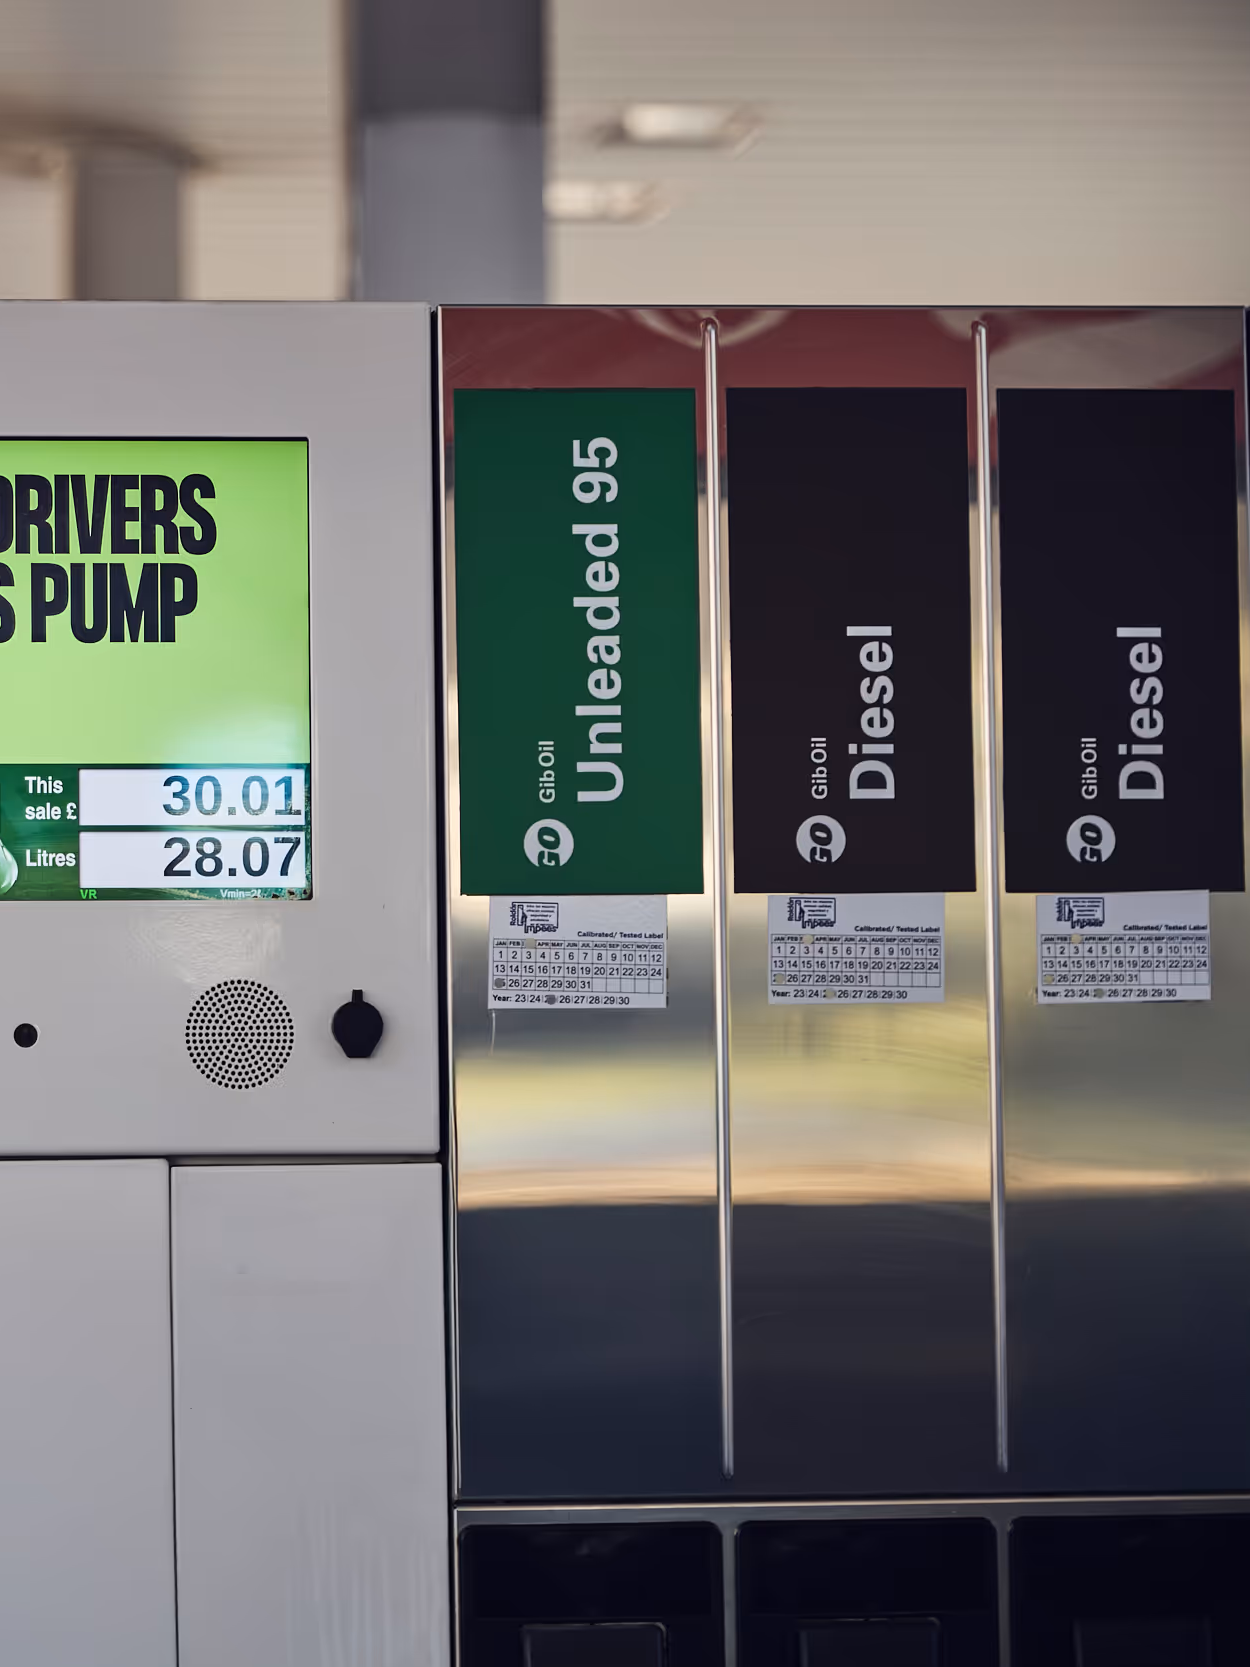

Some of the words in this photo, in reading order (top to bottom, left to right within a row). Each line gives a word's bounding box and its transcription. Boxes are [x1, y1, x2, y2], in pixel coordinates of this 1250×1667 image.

[573, 437, 618, 503] 95
[31, 563, 198, 643] PUMP
[572, 524, 624, 802] Unleaded
[847, 626, 895, 799] Diesel
[1117, 627, 1164, 799] Diesel
[25, 776, 63, 793] This
[163, 776, 301, 816] 30.01
[25, 803, 61, 820] sale
[66, 803, 77, 820] £
[26, 849, 76, 866] Litres
[164, 837, 301, 876] 28.07
[80, 889, 97, 899] VR
[512, 951, 517, 959] 2
[526, 951, 531, 959] 3
[555, 952, 560, 960] 5
[569, 952, 574, 960] 6
[583, 952, 588, 960] 7
[597, 953, 602, 961] 8
[611, 953, 617, 961] 9
[639, 954, 646, 962] 11
[652, 954, 661, 962] 12
[790, 946, 796, 954] 2
[804, 946, 809, 954] 3
[832, 947, 838, 955] 5
[846, 947, 852, 955] 6
[860, 947, 866, 955] 7
[874, 947, 880, 956] 8
[888, 947, 894, 955] 9
[901, 948, 911, 956] 10
[916, 948, 924, 956] 11
[929, 948, 938, 956] 12
[1047, 946, 1050, 954] 1
[1060, 946, 1065, 954] 2
[1074, 946, 1079, 954] 3
[1102, 946, 1107, 954] 5
[1115, 946, 1121, 954] 6
[1144, 946, 1149, 954] 8
[1157, 946, 1163, 954] 9
[1169, 946, 1180, 954] 10
[1184, 946, 1193, 954] 11
[1197, 946, 1207, 954] 12
[496, 965, 505, 973] 13
[510, 965, 519, 973] 14
[538, 966, 548, 974] 16
[552, 966, 562, 974] 17
[566, 966, 576, 974] 18
[581, 967, 590, 975] 19
[594, 967, 606, 975] 20
[622, 968, 633, 976] 22
[637, 968, 648, 976] 23
[651, 968, 662, 976] 24
[774, 960, 784, 968] 13
[816, 961, 826, 969] 16
[830, 961, 840, 969] 17
[844, 961, 854, 969] 18
[858, 961, 868, 969] 19
[872, 961, 883, 970] 20
[886, 962, 896, 970] 21
[900, 962, 911, 970] 22
[914, 962, 925, 970] 23
[928, 962, 938, 970] 24
[1044, 960, 1054, 968] 13
[1072, 960, 1082, 968] 15
[1086, 960, 1096, 968] 16
[1100, 960, 1109, 968] 17
[1114, 960, 1124, 968] 18
[1128, 960, 1138, 968] 19
[1141, 960, 1152, 968] 20
[1156, 960, 1165, 968] 21
[1169, 960, 1180, 968] 22
[1183, 960, 1194, 968] 23
[1197, 960, 1207, 968] 24
[509, 979, 520, 987] 26
[523, 979, 534, 987] 27
[537, 980, 548, 988] 28
[551, 980, 562, 988] 29
[580, 981, 590, 989] 31
[788, 974, 798, 982] 26
[815, 974, 826, 982] 28
[830, 975, 841, 983] 29
[844, 975, 855, 983] 30
[858, 975, 868, 983] 31
[1058, 974, 1069, 982] 26
[1072, 974, 1082, 982] 27
[1086, 974, 1096, 982] 28
[1100, 974, 1110, 982] 29
[1114, 974, 1124, 982] 30
[1128, 974, 1138, 982] 31
